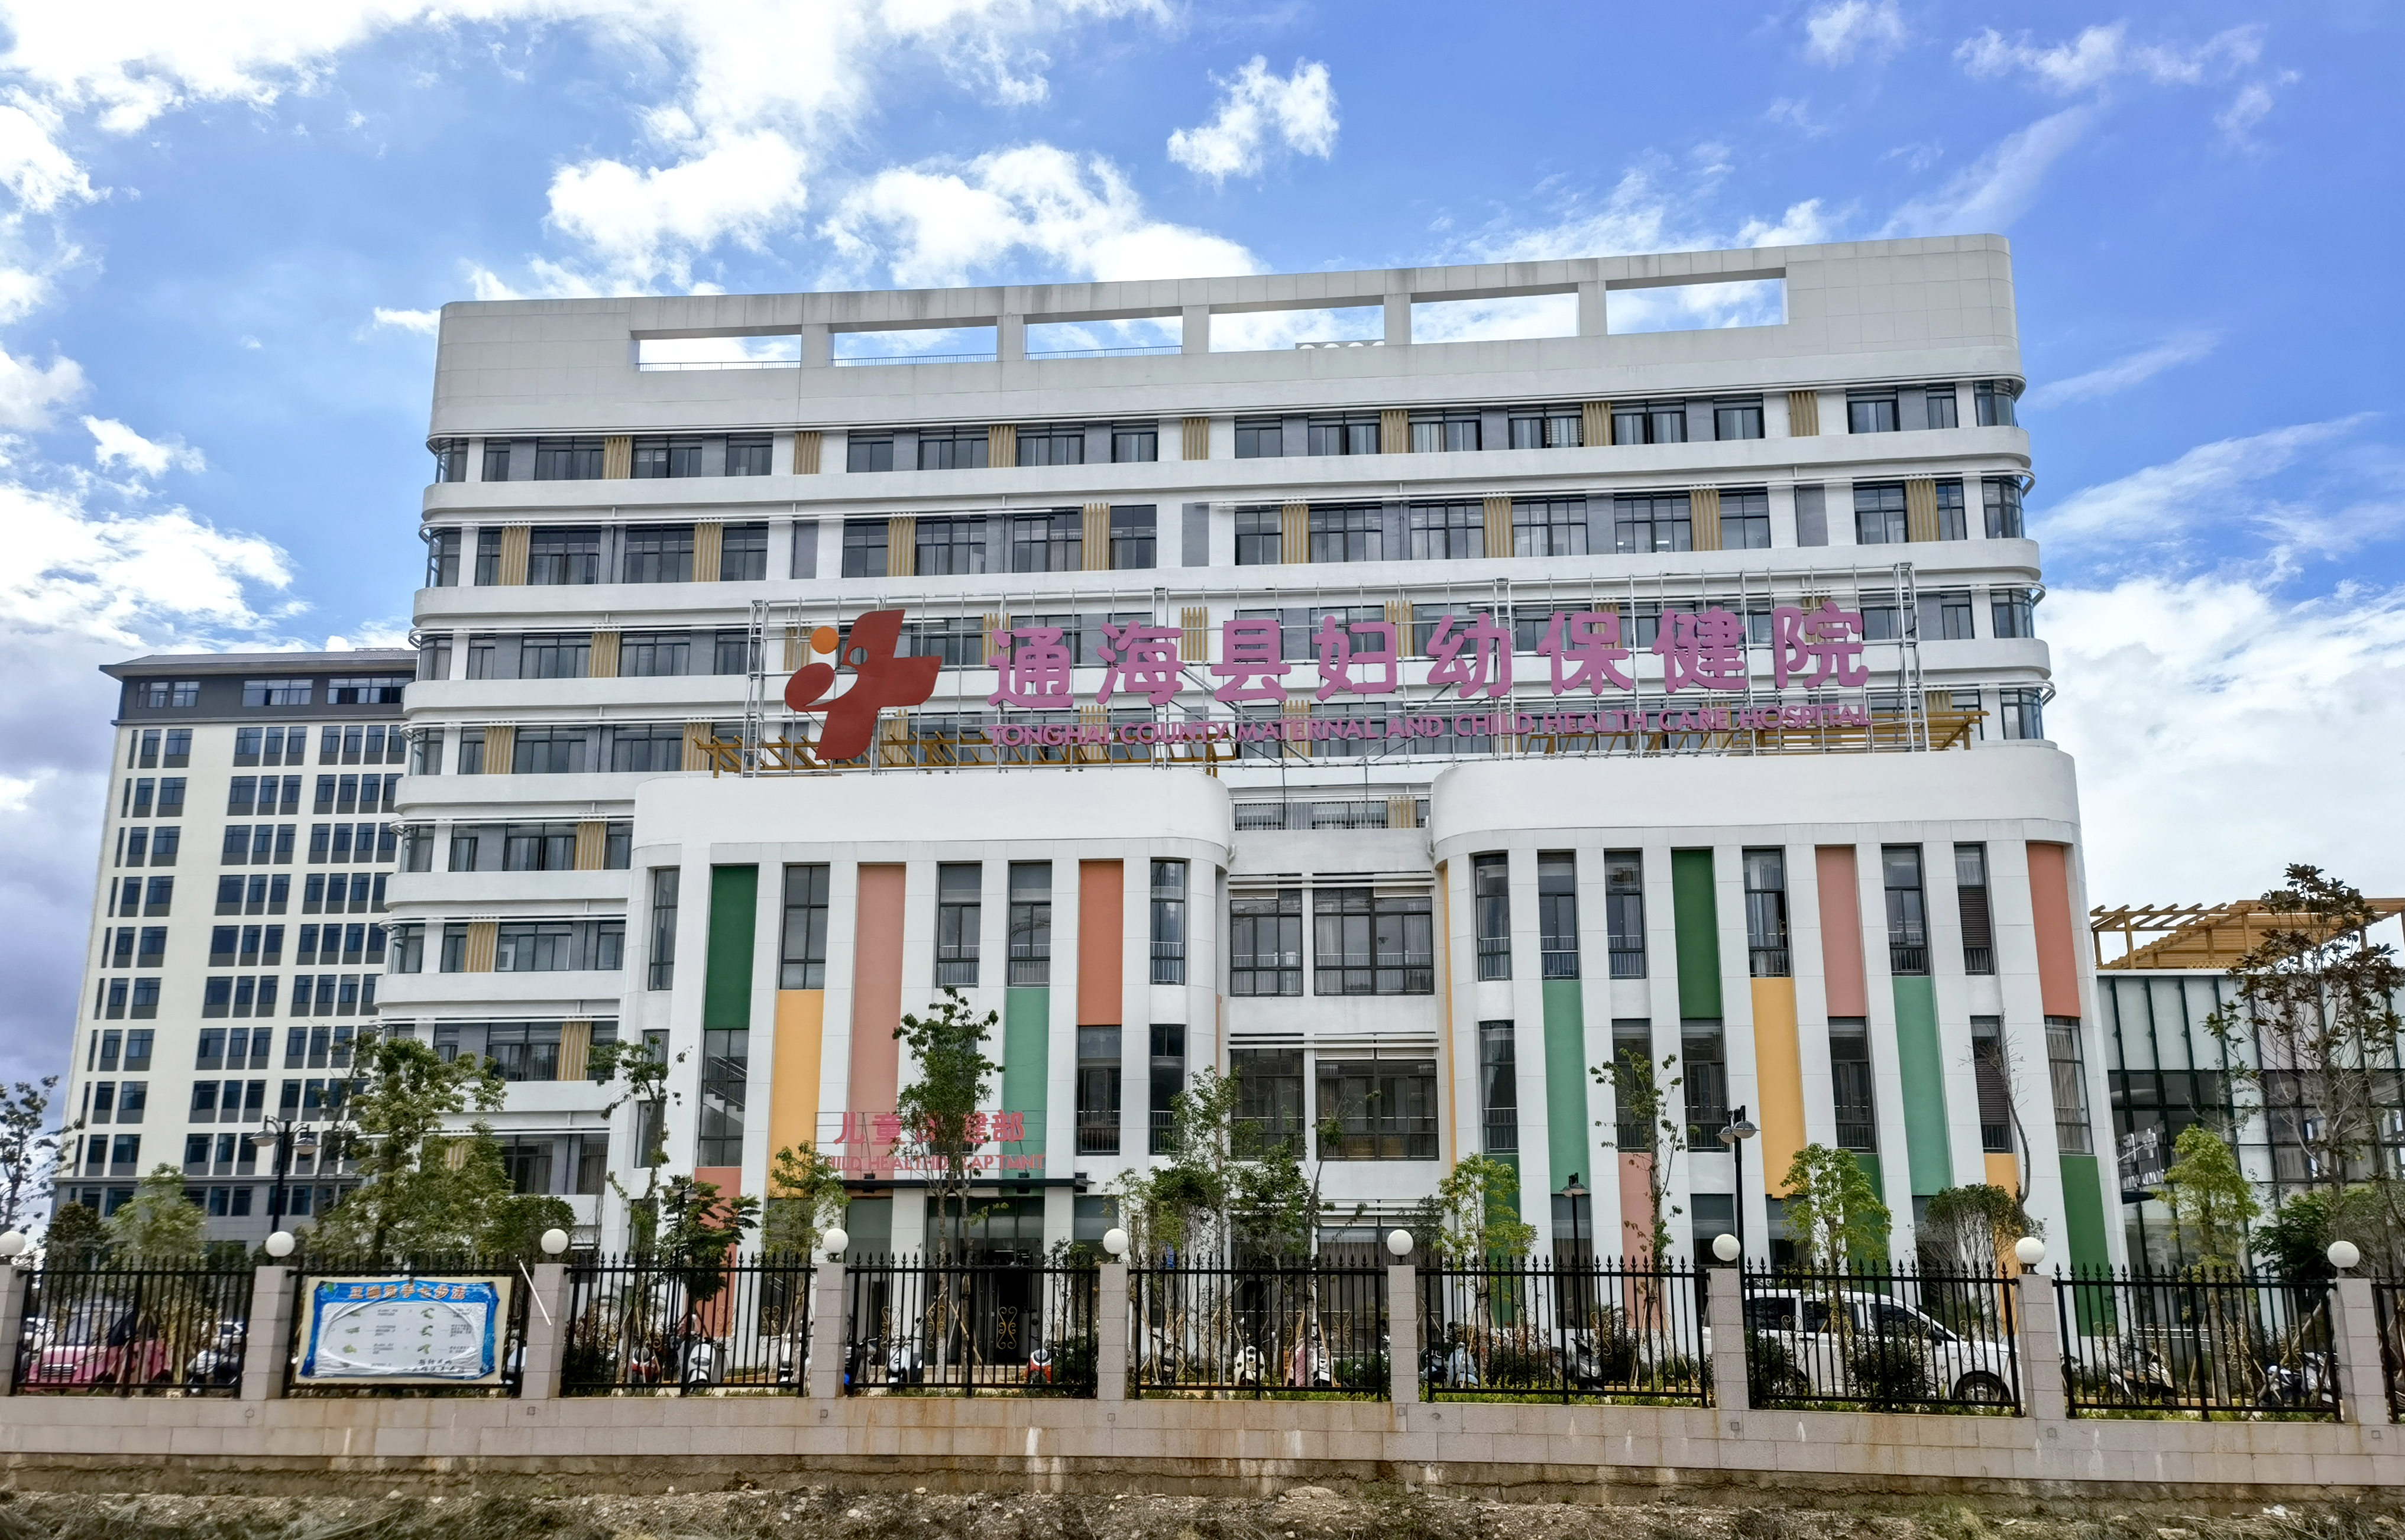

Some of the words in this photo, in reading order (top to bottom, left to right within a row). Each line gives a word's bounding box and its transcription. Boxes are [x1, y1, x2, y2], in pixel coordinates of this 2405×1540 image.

[988, 599, 1869, 708] 通海县妇幼保健院
[988, 723, 1110, 747] TONGHAI
[1118, 721, 1229, 745] COUNTY
[1236, 717, 1378, 743] MATERNAL
[1384, 715, 1444, 739] AND
[1454, 711, 1535, 737] CHILD
[1542, 709, 1648, 734] HEALTH
[1658, 707, 1730, 732] CARE
[1739, 703, 1872, 730] HOSPITAL
